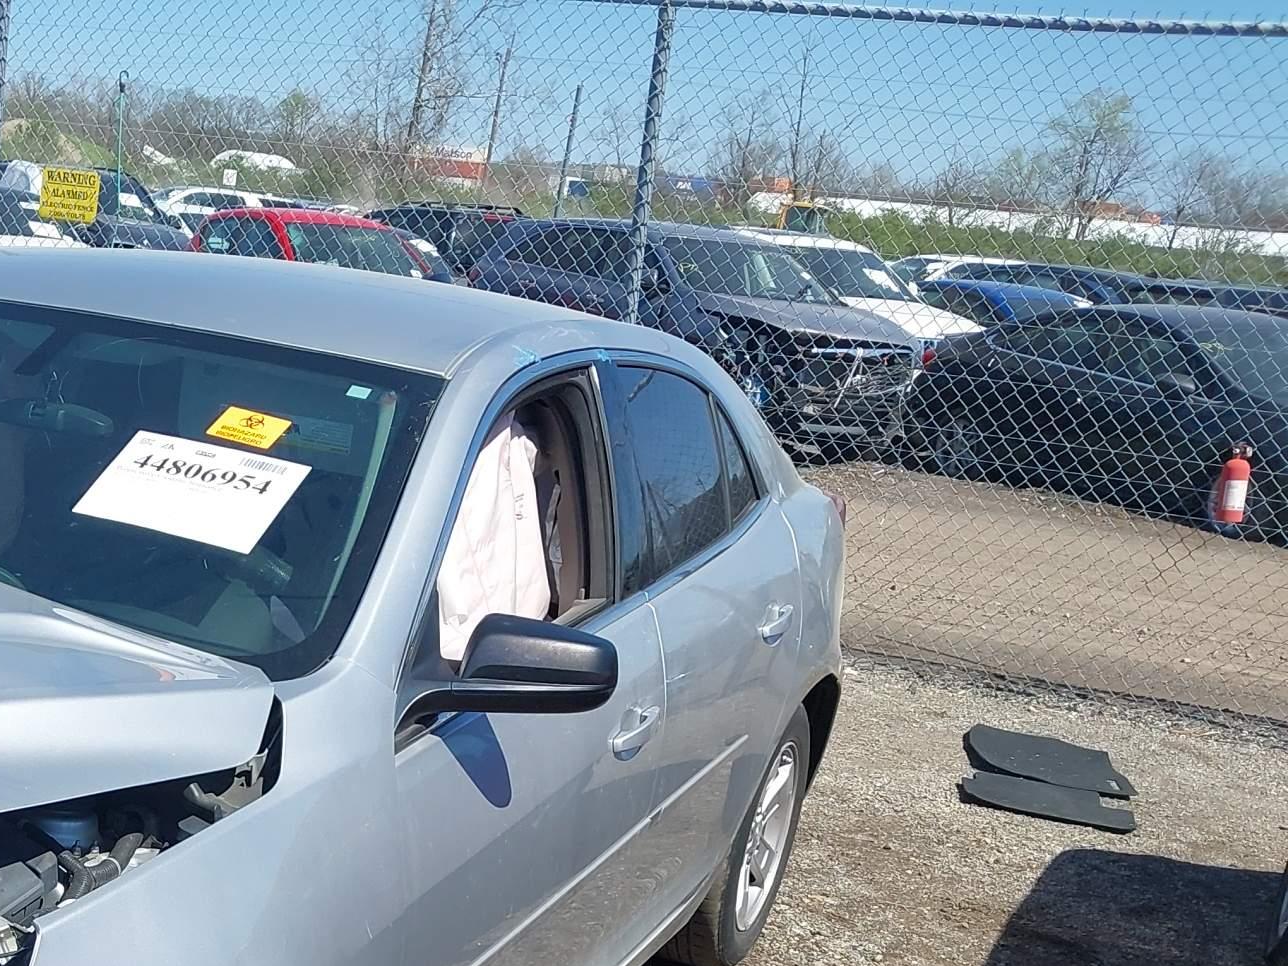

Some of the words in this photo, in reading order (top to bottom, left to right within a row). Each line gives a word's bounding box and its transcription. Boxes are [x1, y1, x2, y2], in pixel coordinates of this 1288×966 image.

[435, 146, 472, 159] Matson
[47, 171, 96, 186] WARNING
[52, 188, 88, 201] ALARMED
[215, 430, 263, 446] BIOPELIGRO
[220, 424, 268, 440] BIOHAZARD
[133, 453, 272, 495] 44806954
